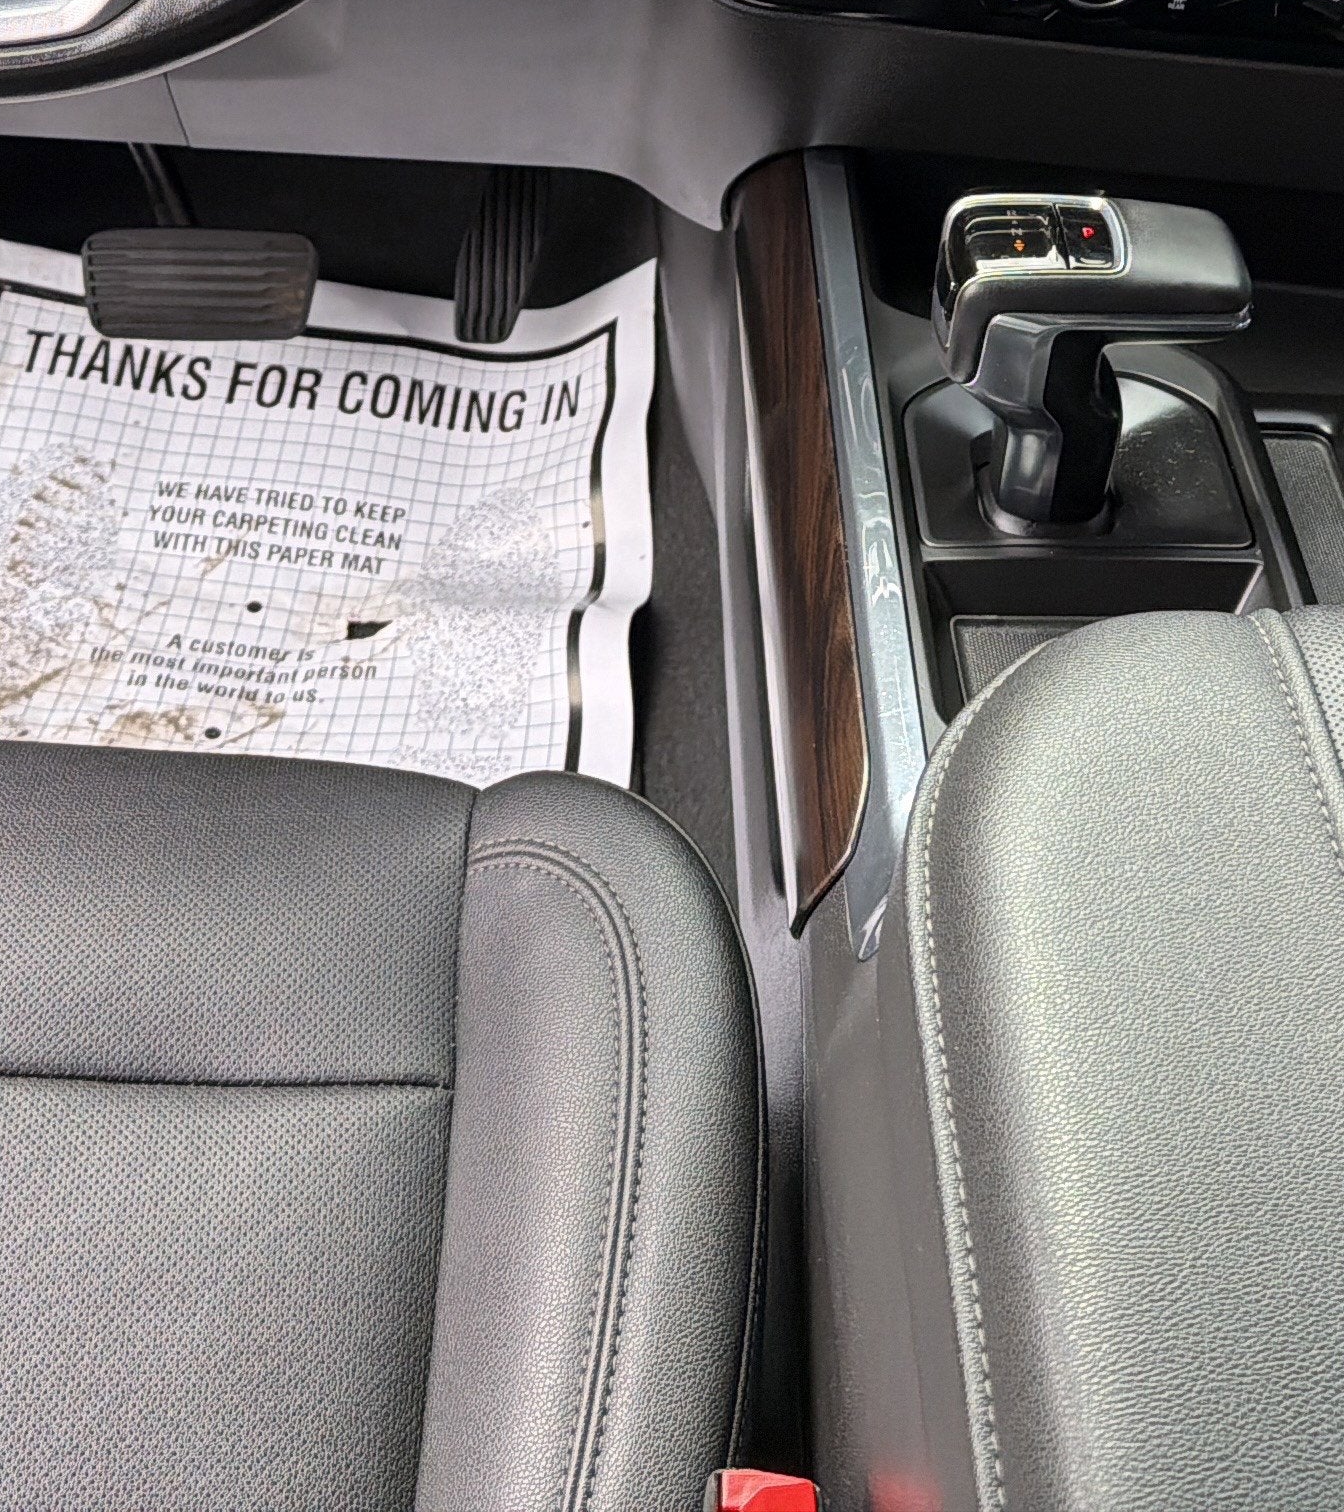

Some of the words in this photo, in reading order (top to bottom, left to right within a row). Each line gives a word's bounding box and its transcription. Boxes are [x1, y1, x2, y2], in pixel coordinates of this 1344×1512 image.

[24, 330, 212, 402] THANKS
[225, 362, 321, 410] FOR
[338, 374, 527, 432] COMING
[540, 376, 582, 426] IN
[157, 480, 190, 499] WE
[194, 483, 248, 505] HAVE
[255, 488, 314, 512] TRIED
[321, 495, 348, 516] TO
[354, 501, 406, 524] KEEP
[149, 504, 205, 526] YOUR
[212, 509, 328, 540] CARPETING
[335, 524, 402, 551] CLEAN
[153, 530, 206, 554] WITH
[215, 536, 261, 561] THIS
[266, 543, 333, 569] PAPER
[340, 552, 385, 575] MAT
[90, 645, 124, 664] the
[130, 649, 186, 671] most
[192, 658, 298, 686] important
[302, 662, 377, 683] person
[166, 633, 182, 649] A
[189, 637, 291, 663] customer
[126, 669, 146, 688] in
[155, 672, 189, 692] the
[197, 680, 257, 703] world
[264, 689, 286, 705] to
[292, 687, 325, 704] us.
